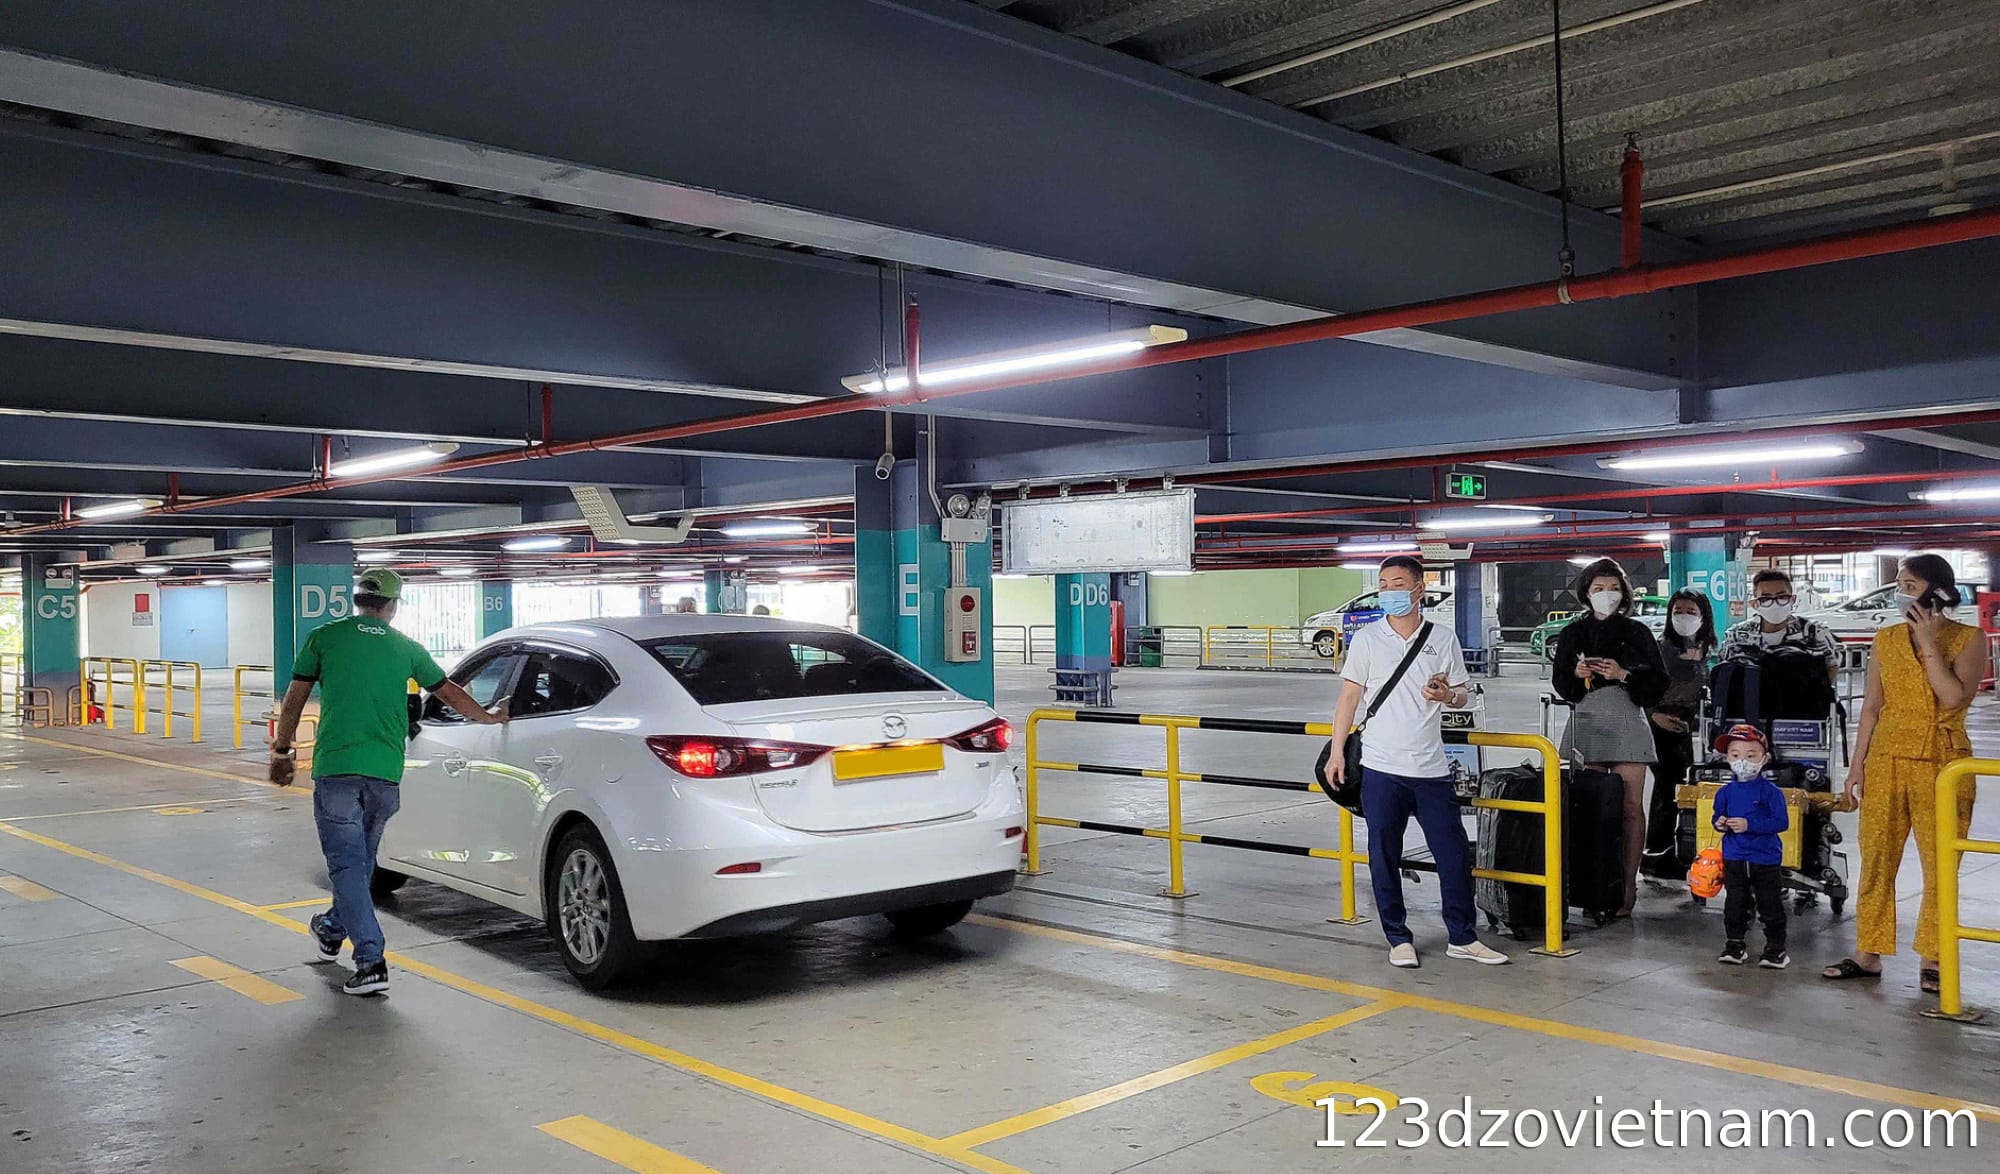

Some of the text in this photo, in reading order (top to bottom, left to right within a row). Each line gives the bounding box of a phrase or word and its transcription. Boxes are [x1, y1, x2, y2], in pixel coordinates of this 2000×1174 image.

[301, 585, 348, 618] D5
[485, 596, 503, 612] B6
[1086, 583, 1108, 606] D6
[37, 594, 76, 619] C5
[357, 623, 386, 635] Grab
